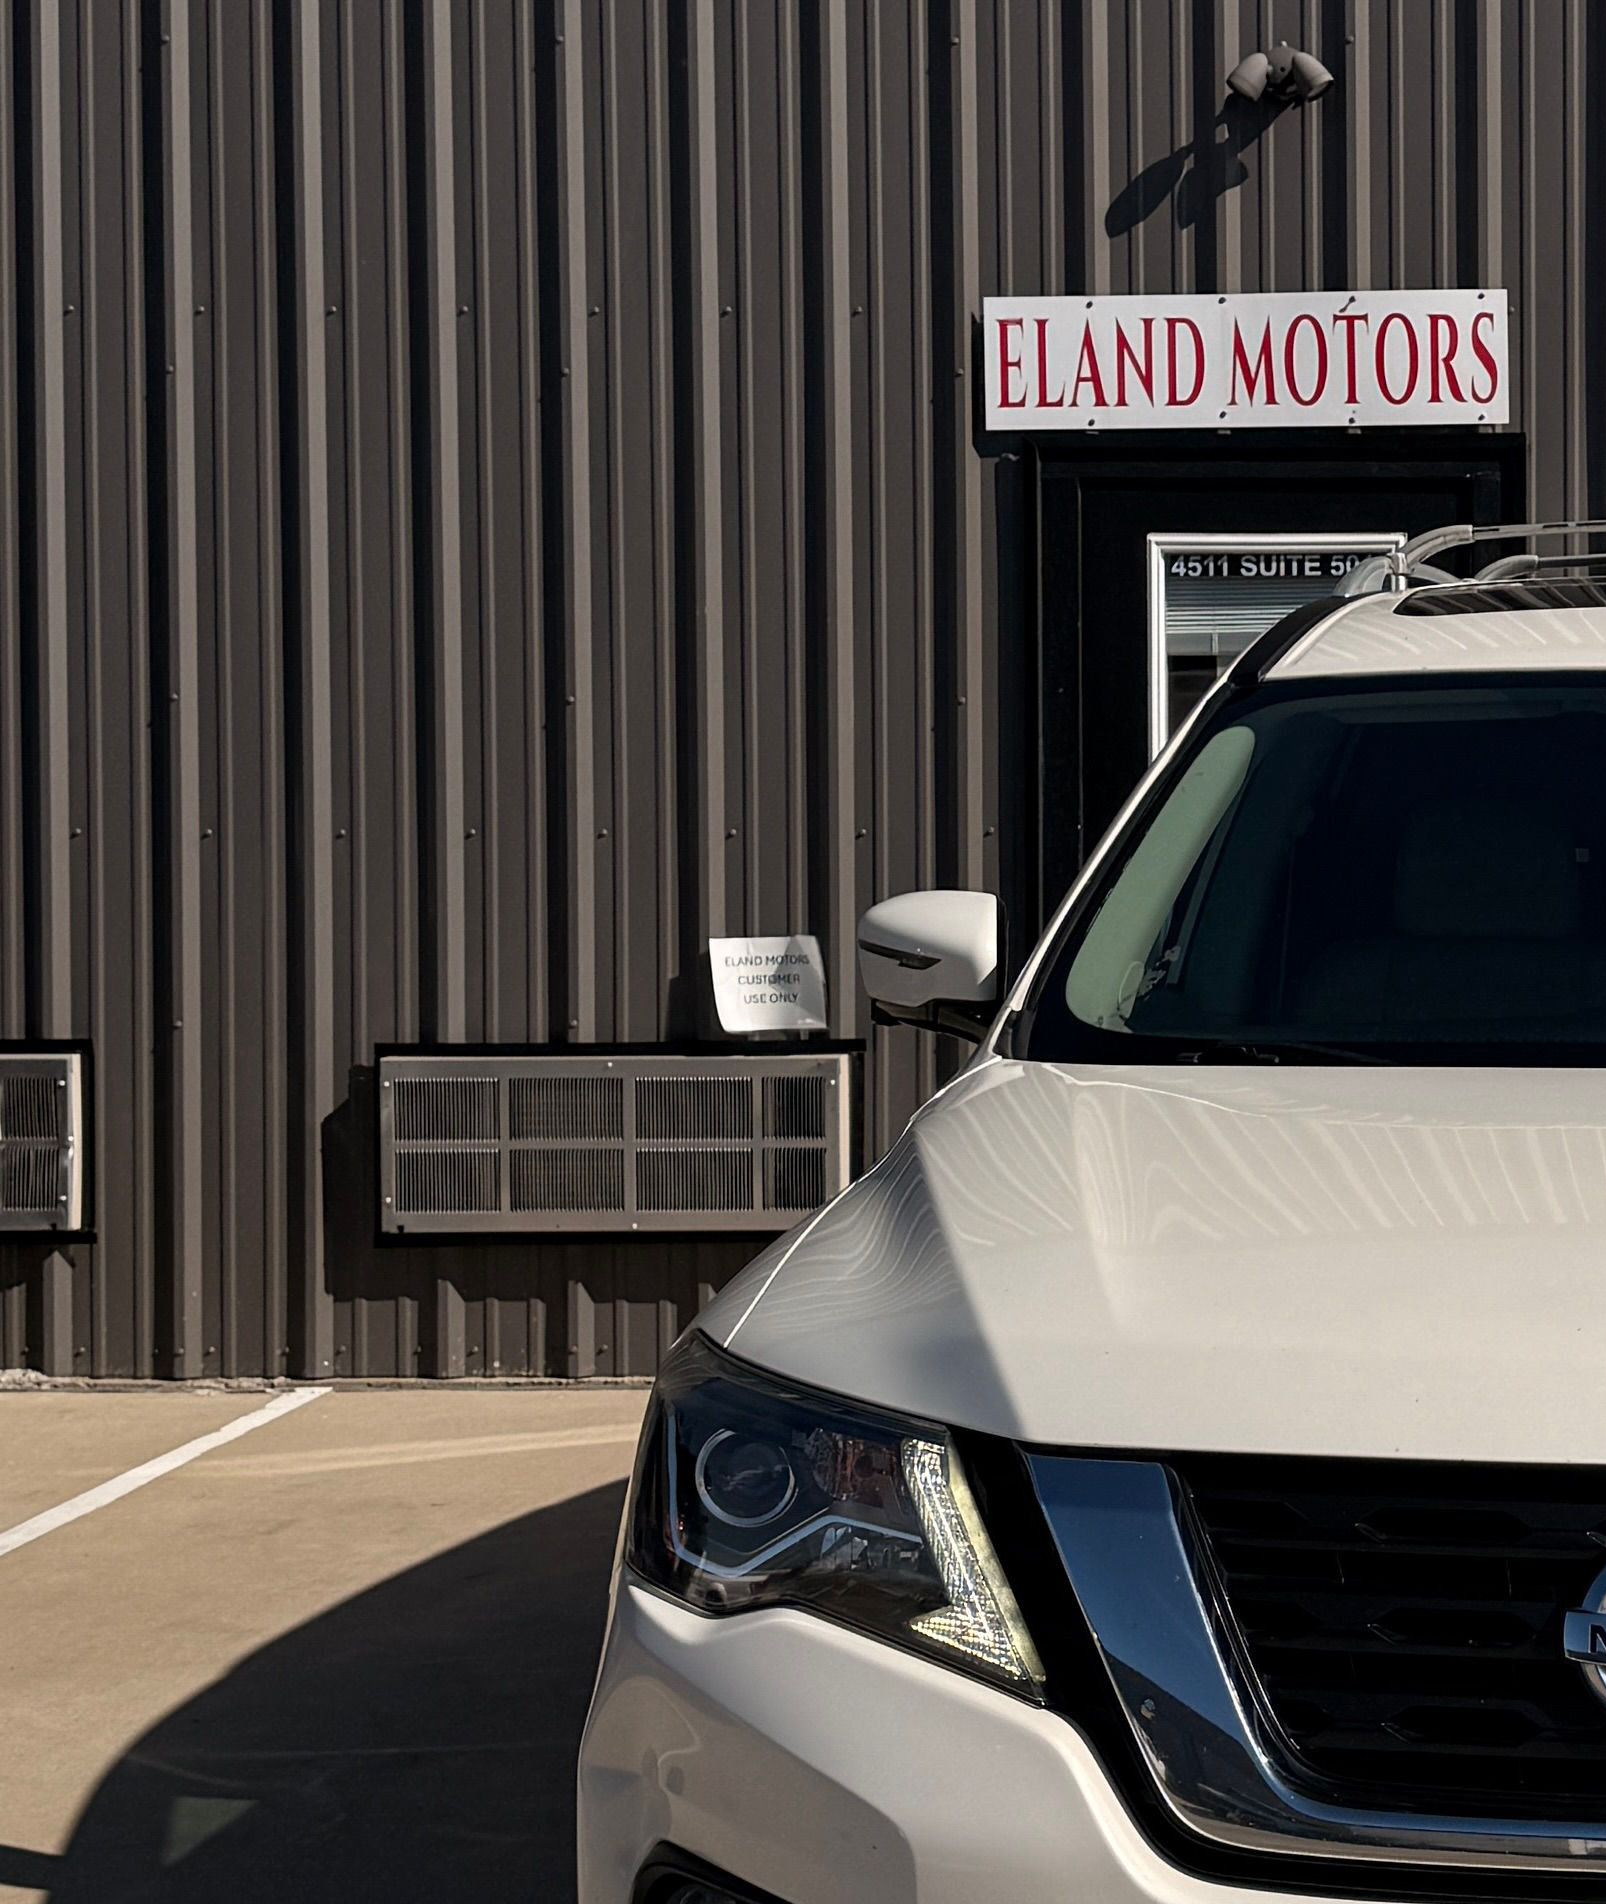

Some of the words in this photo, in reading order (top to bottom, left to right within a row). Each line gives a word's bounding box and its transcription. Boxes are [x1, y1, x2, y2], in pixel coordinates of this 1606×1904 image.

[996, 316, 1205, 409] ELAND
[1226, 310, 1499, 407] MOTORS
[1170, 555, 1229, 577] 4511
[1240, 555, 1322, 577] SUITE
[1330, 554, 1373, 577] 50
[724, 955, 763, 967] ELAND
[765, 954, 810, 966] MOTORS
[737, 973, 801, 985] CUSTOMER
[743, 993, 767, 1004] USE
[769, 992, 799, 1004] ONLY
